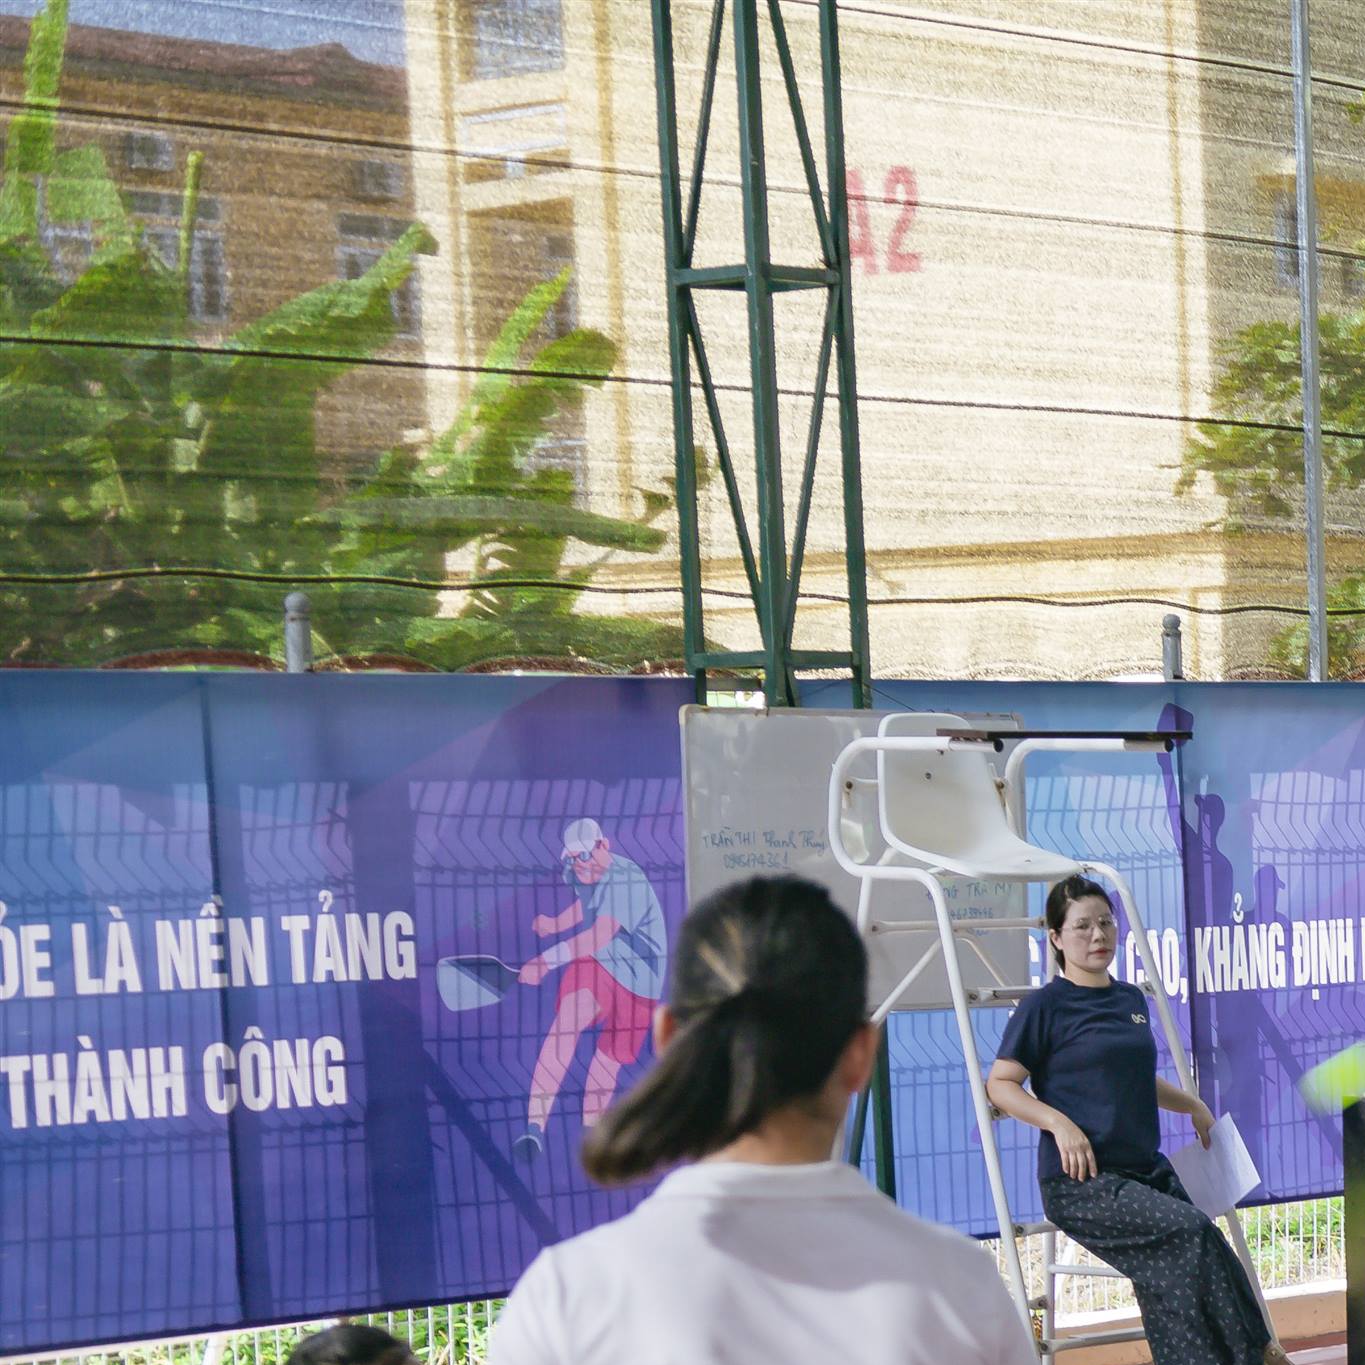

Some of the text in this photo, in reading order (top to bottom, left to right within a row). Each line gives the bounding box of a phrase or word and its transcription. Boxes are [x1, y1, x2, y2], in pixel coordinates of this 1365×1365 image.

[71, 905, 143, 995] LÀ
[155, 894, 269, 991] NỀN
[281, 890, 418, 985] TẢNG
[1194, 892, 1286, 994] KHẲNG
[1291, 918, 1355, 1000] ĐỊNH
[0, 1026, 348, 1129] THÀNH CÔNG
